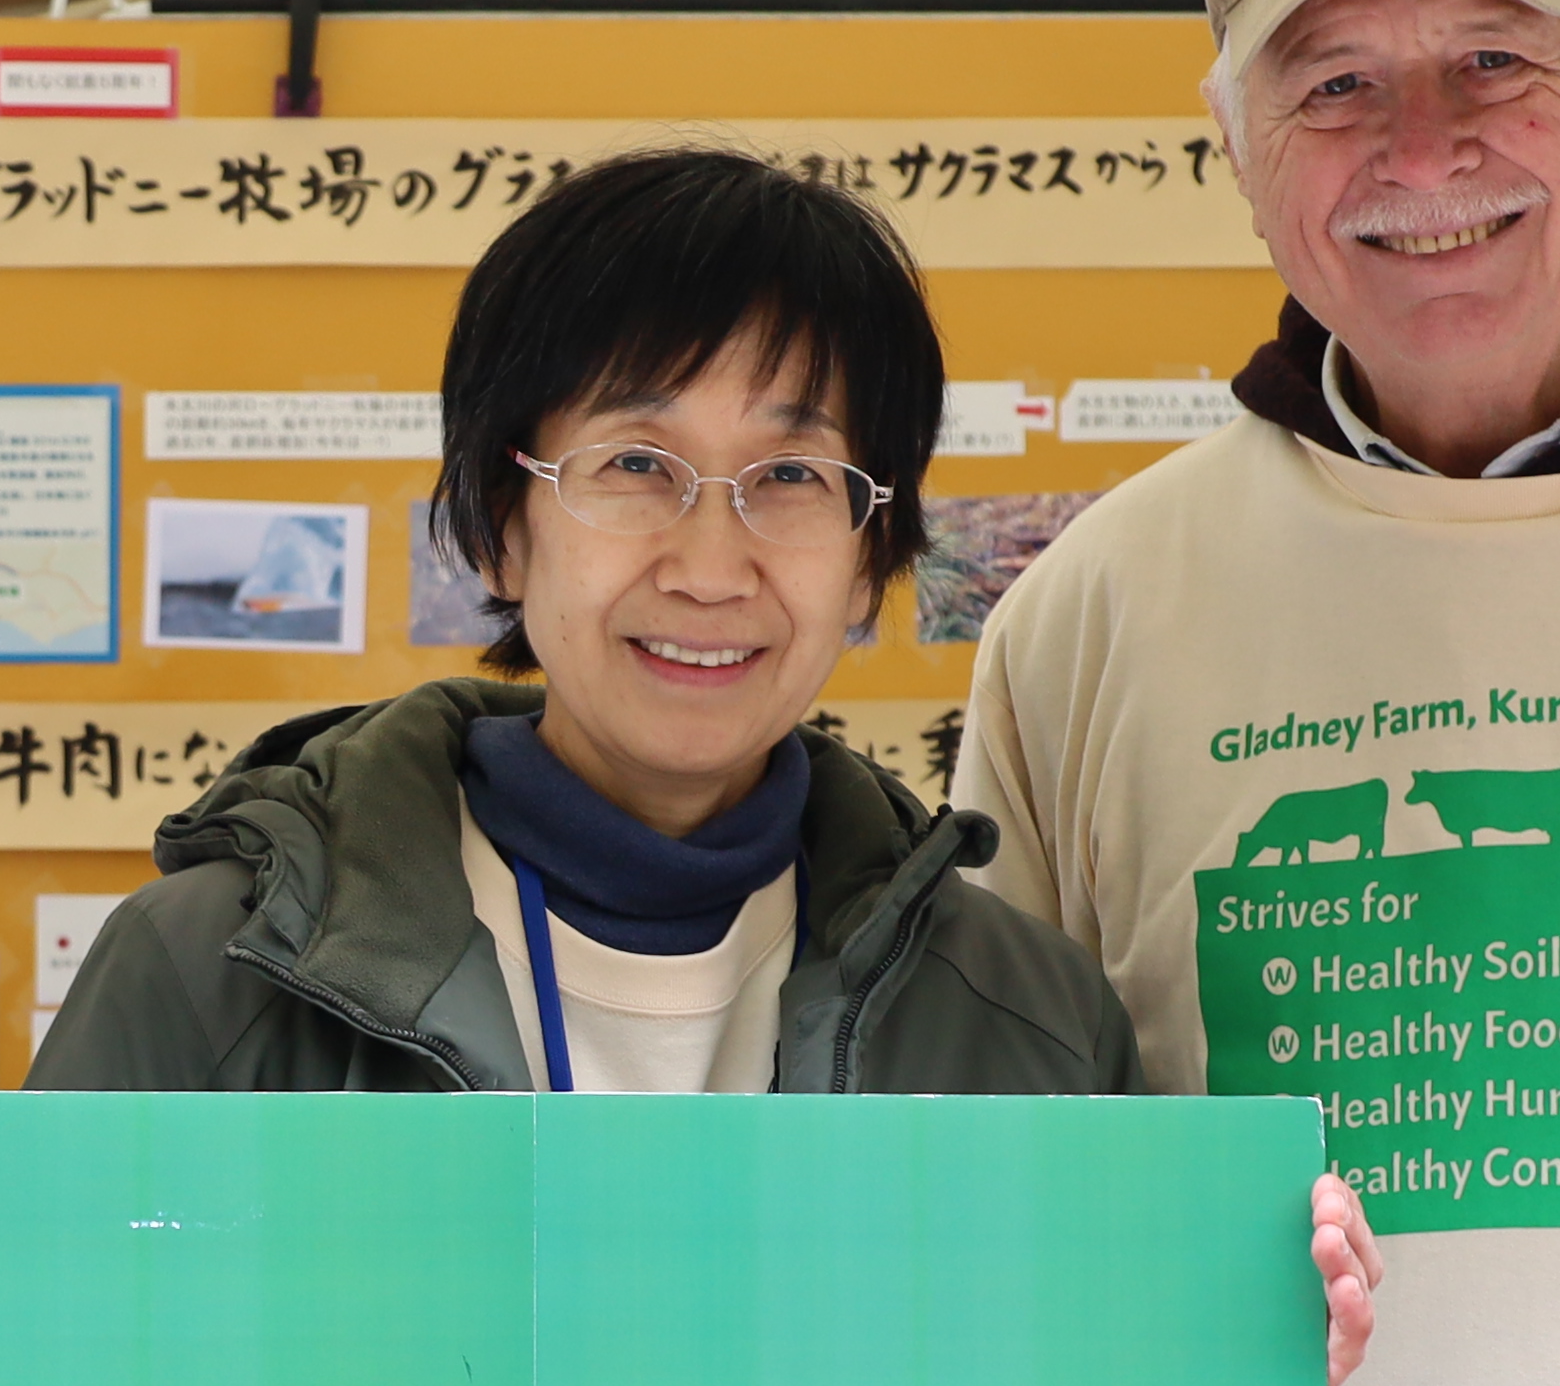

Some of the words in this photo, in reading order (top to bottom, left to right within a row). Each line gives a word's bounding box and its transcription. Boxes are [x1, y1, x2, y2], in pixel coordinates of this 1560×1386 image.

[1209, 712, 1364, 767] Gladney
[1372, 694, 1476, 740] Farm,
[1216, 891, 1350, 933] Strives
[1362, 882, 1419, 921] for
[1312, 944, 1473, 994] Healthy
[1483, 936, 1560, 980] Soil
[1312, 1011, 1473, 1062] Healthy
